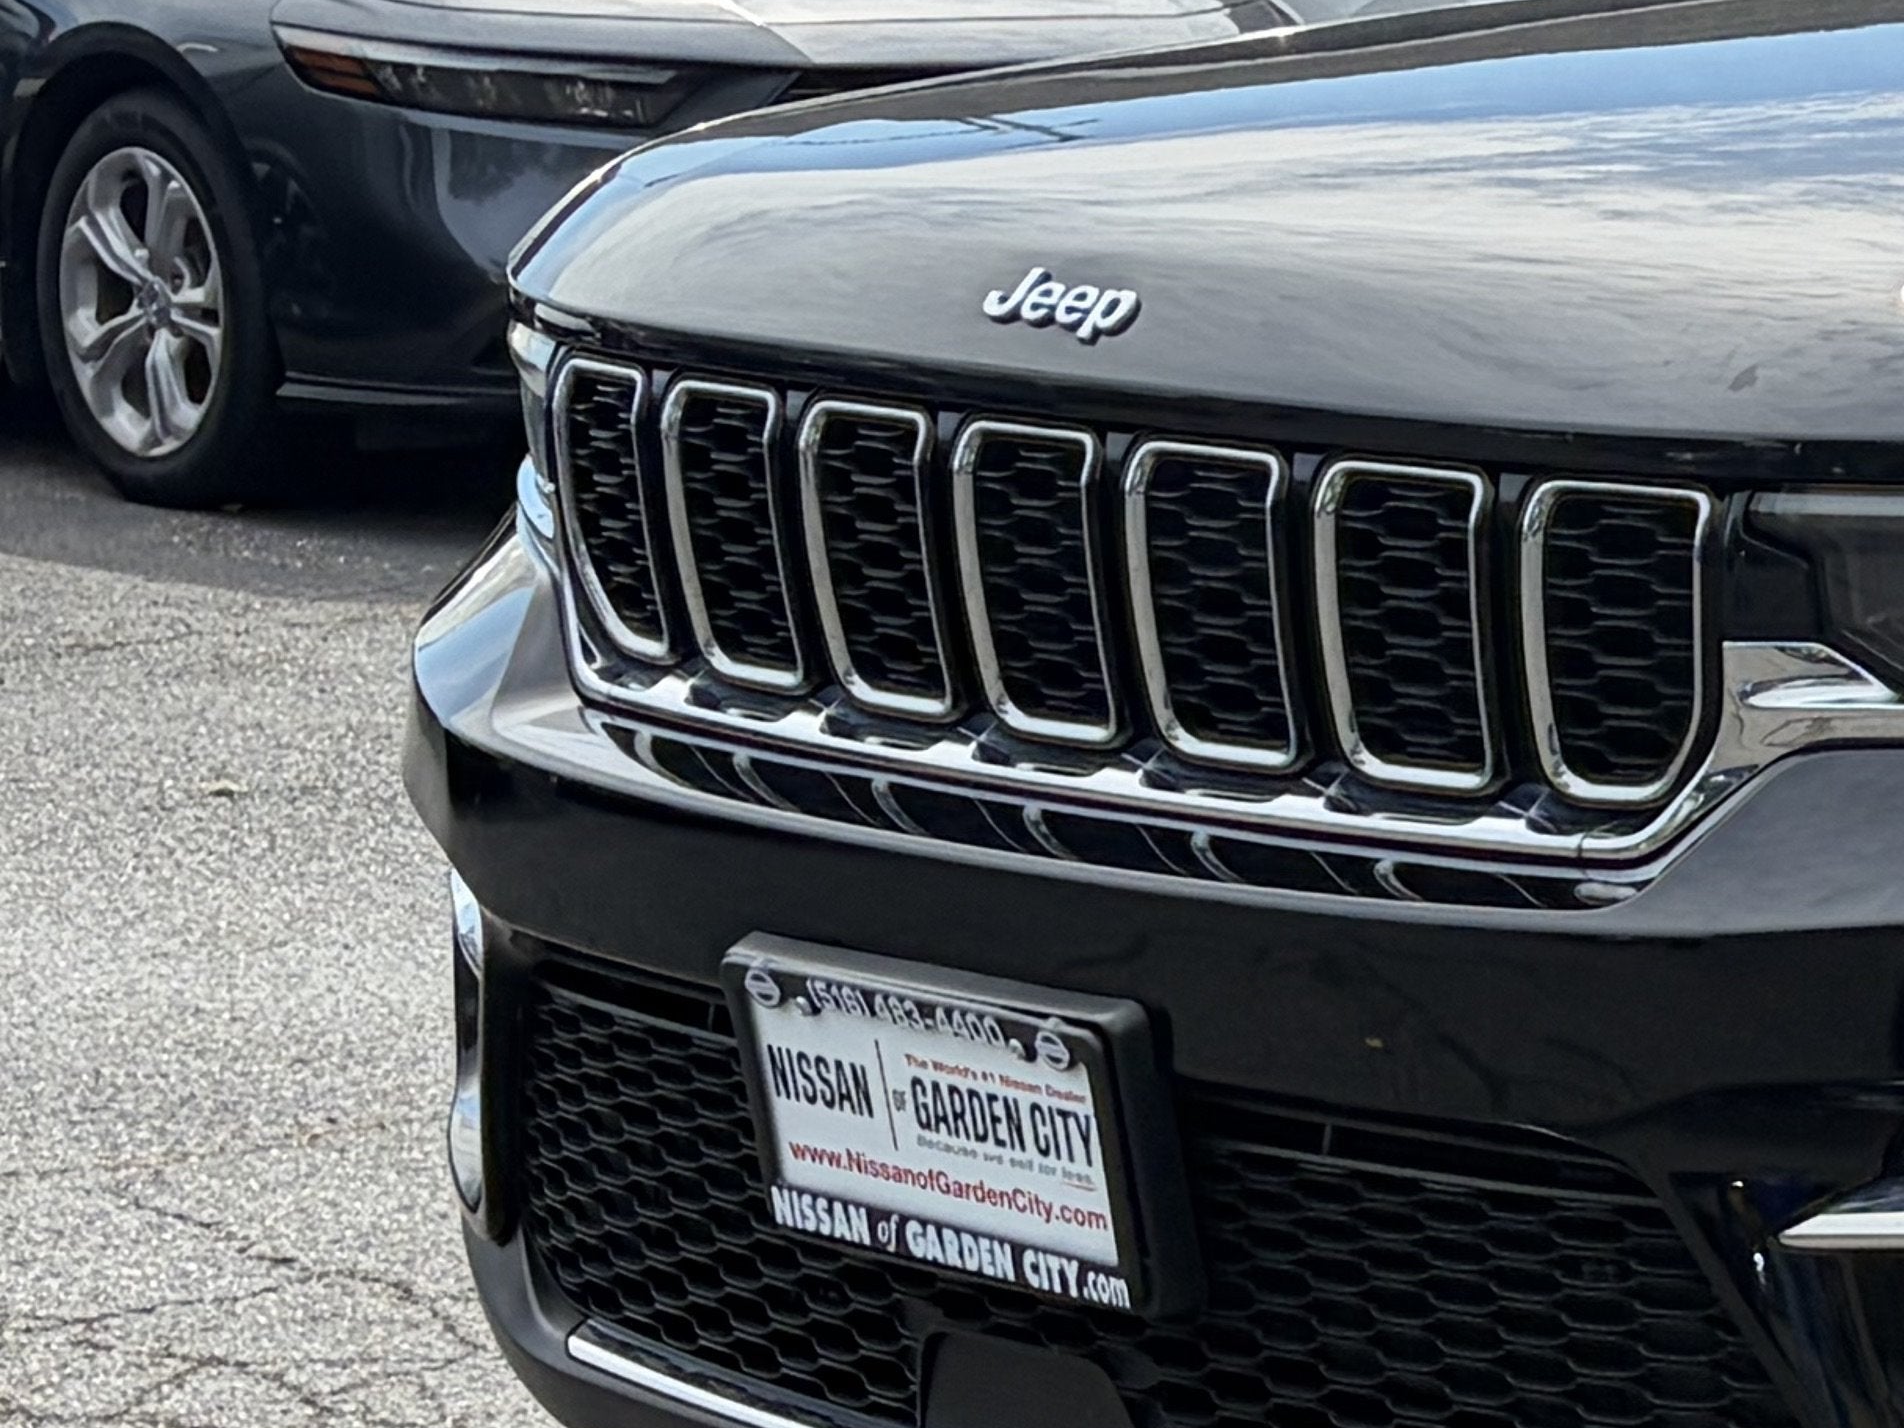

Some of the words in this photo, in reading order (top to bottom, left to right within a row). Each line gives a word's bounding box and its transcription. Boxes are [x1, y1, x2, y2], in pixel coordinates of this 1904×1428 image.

[982, 266, 1140, 345] Jeep
[806, 976, 871, 1018] (516)
[767, 1044, 874, 1118] NISSAN
[905, 1054, 928, 1070] The
[999, 1074, 1043, 1095] Nissan
[1045, 1084, 1087, 1104] Dealer
[911, 1075, 1026, 1153] GARDEN
[1029, 1102, 1093, 1168] CITY
[917, 1133, 978, 1159] Because
[788, 1141, 1108, 1230] www.NissanofGardenCity.com
[771, 1185, 871, 1246] NISSAN
[877, 1213, 899, 1252] of
[905, 1219, 1016, 1282] GARDEN
